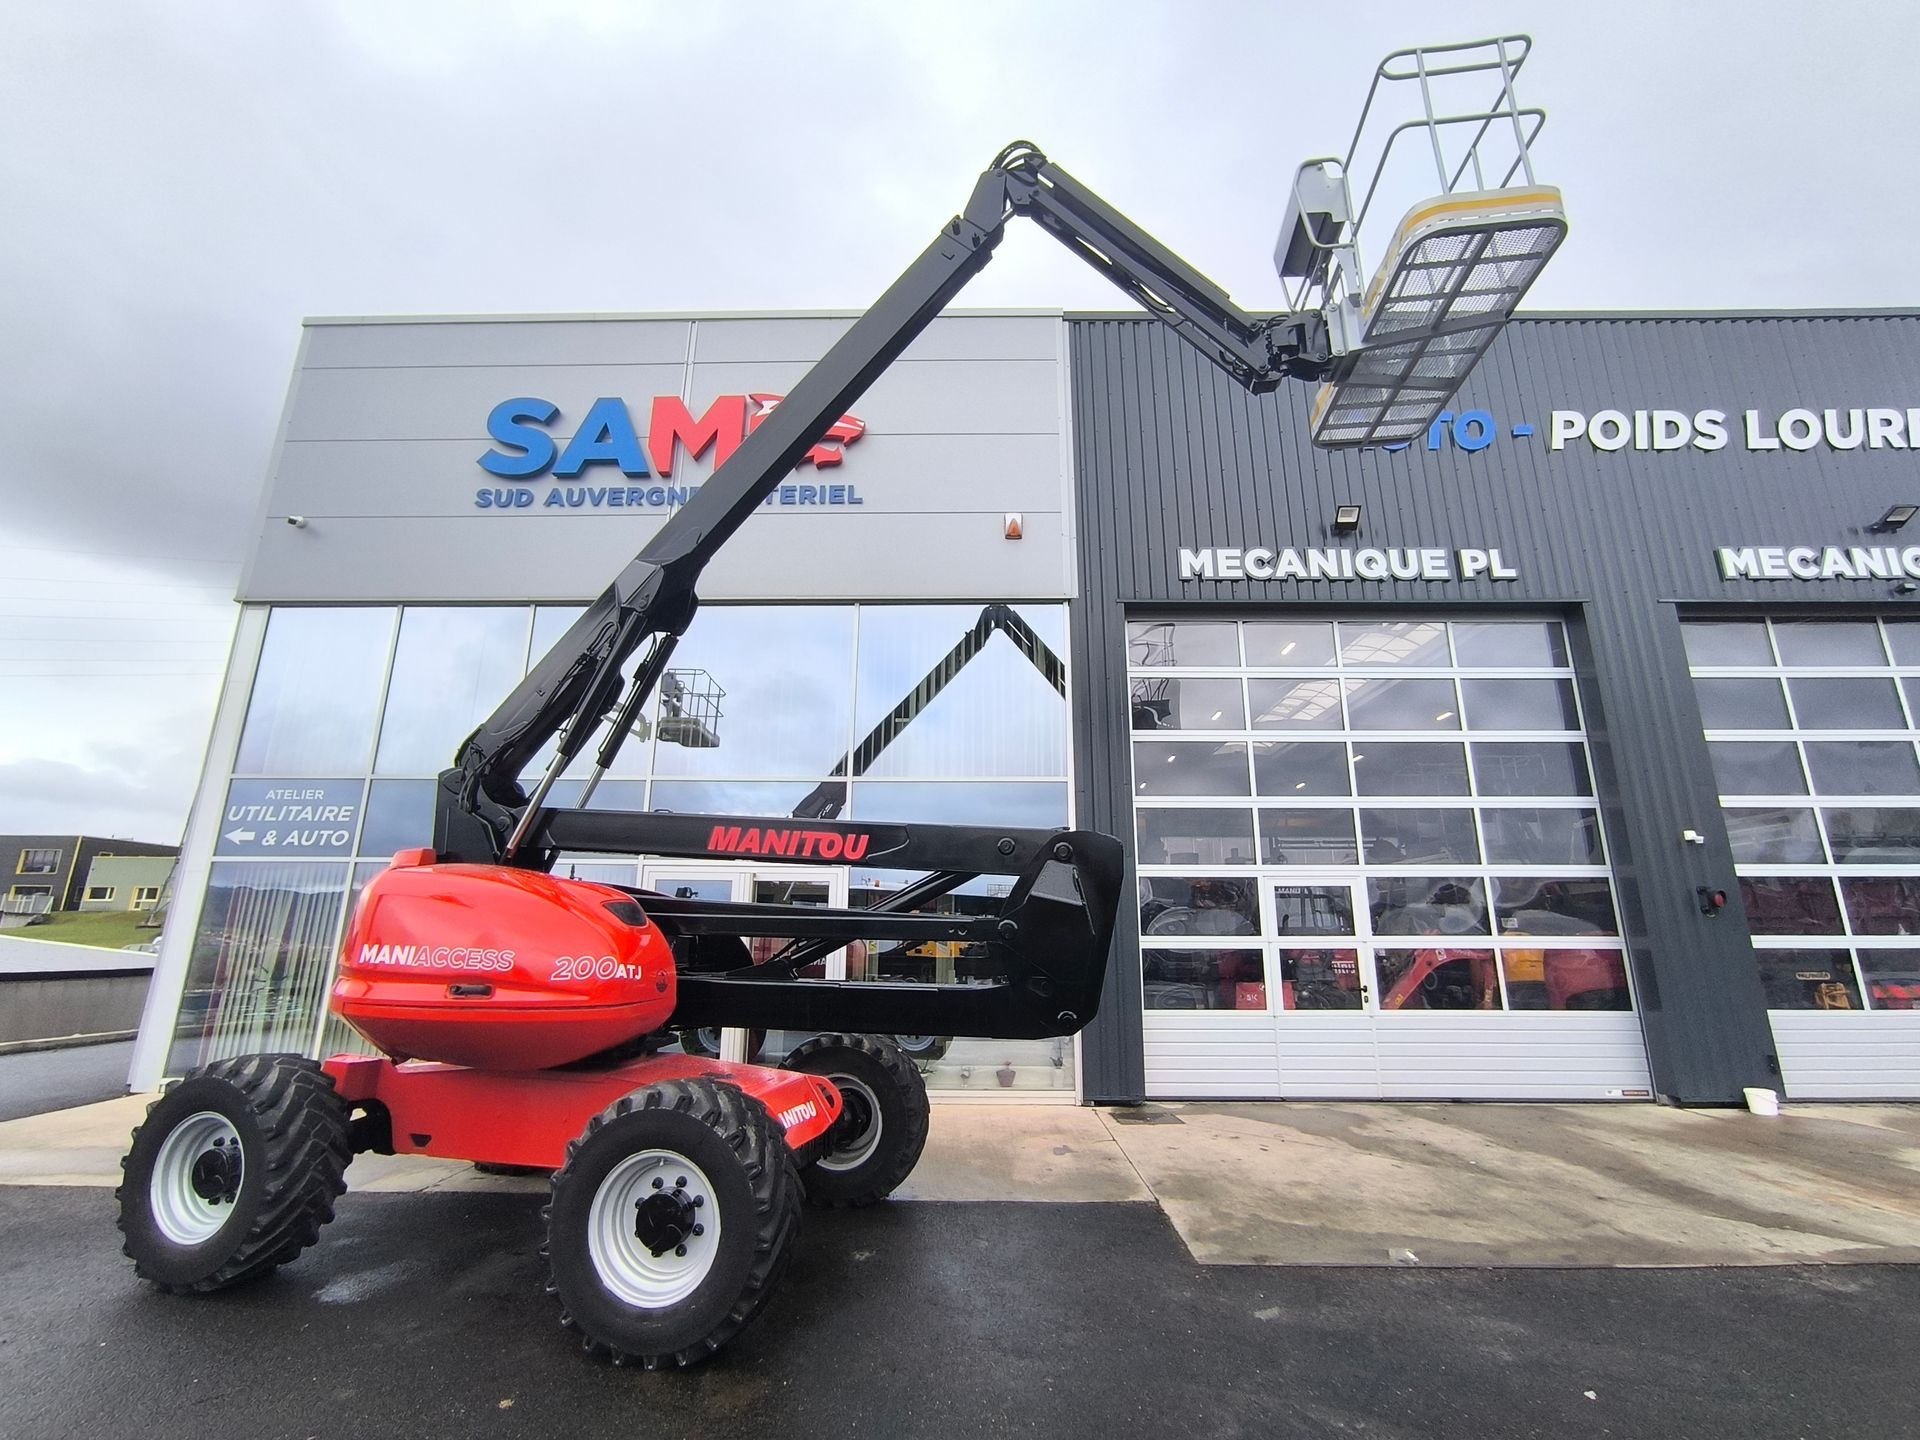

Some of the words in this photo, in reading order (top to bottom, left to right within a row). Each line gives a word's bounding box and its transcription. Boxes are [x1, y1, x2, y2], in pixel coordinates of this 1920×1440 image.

[1551, 409, 1728, 451] POIDS
[475, 488, 534, 508] SUD
[764, 484, 863, 506] TERIEL
[1179, 547, 1451, 581] MECANIQUE
[1460, 547, 1518, 581] PL
[265, 789, 324, 800] ATELIER
[228, 805, 354, 822] UTILITAIRE
[261, 830, 277, 846] &
[282, 830, 350, 846] AUTO
[707, 826, 870, 861] MANITOU
[359, 944, 515, 971] MANIACCESS
[777, 1100, 817, 1129] NITOU
